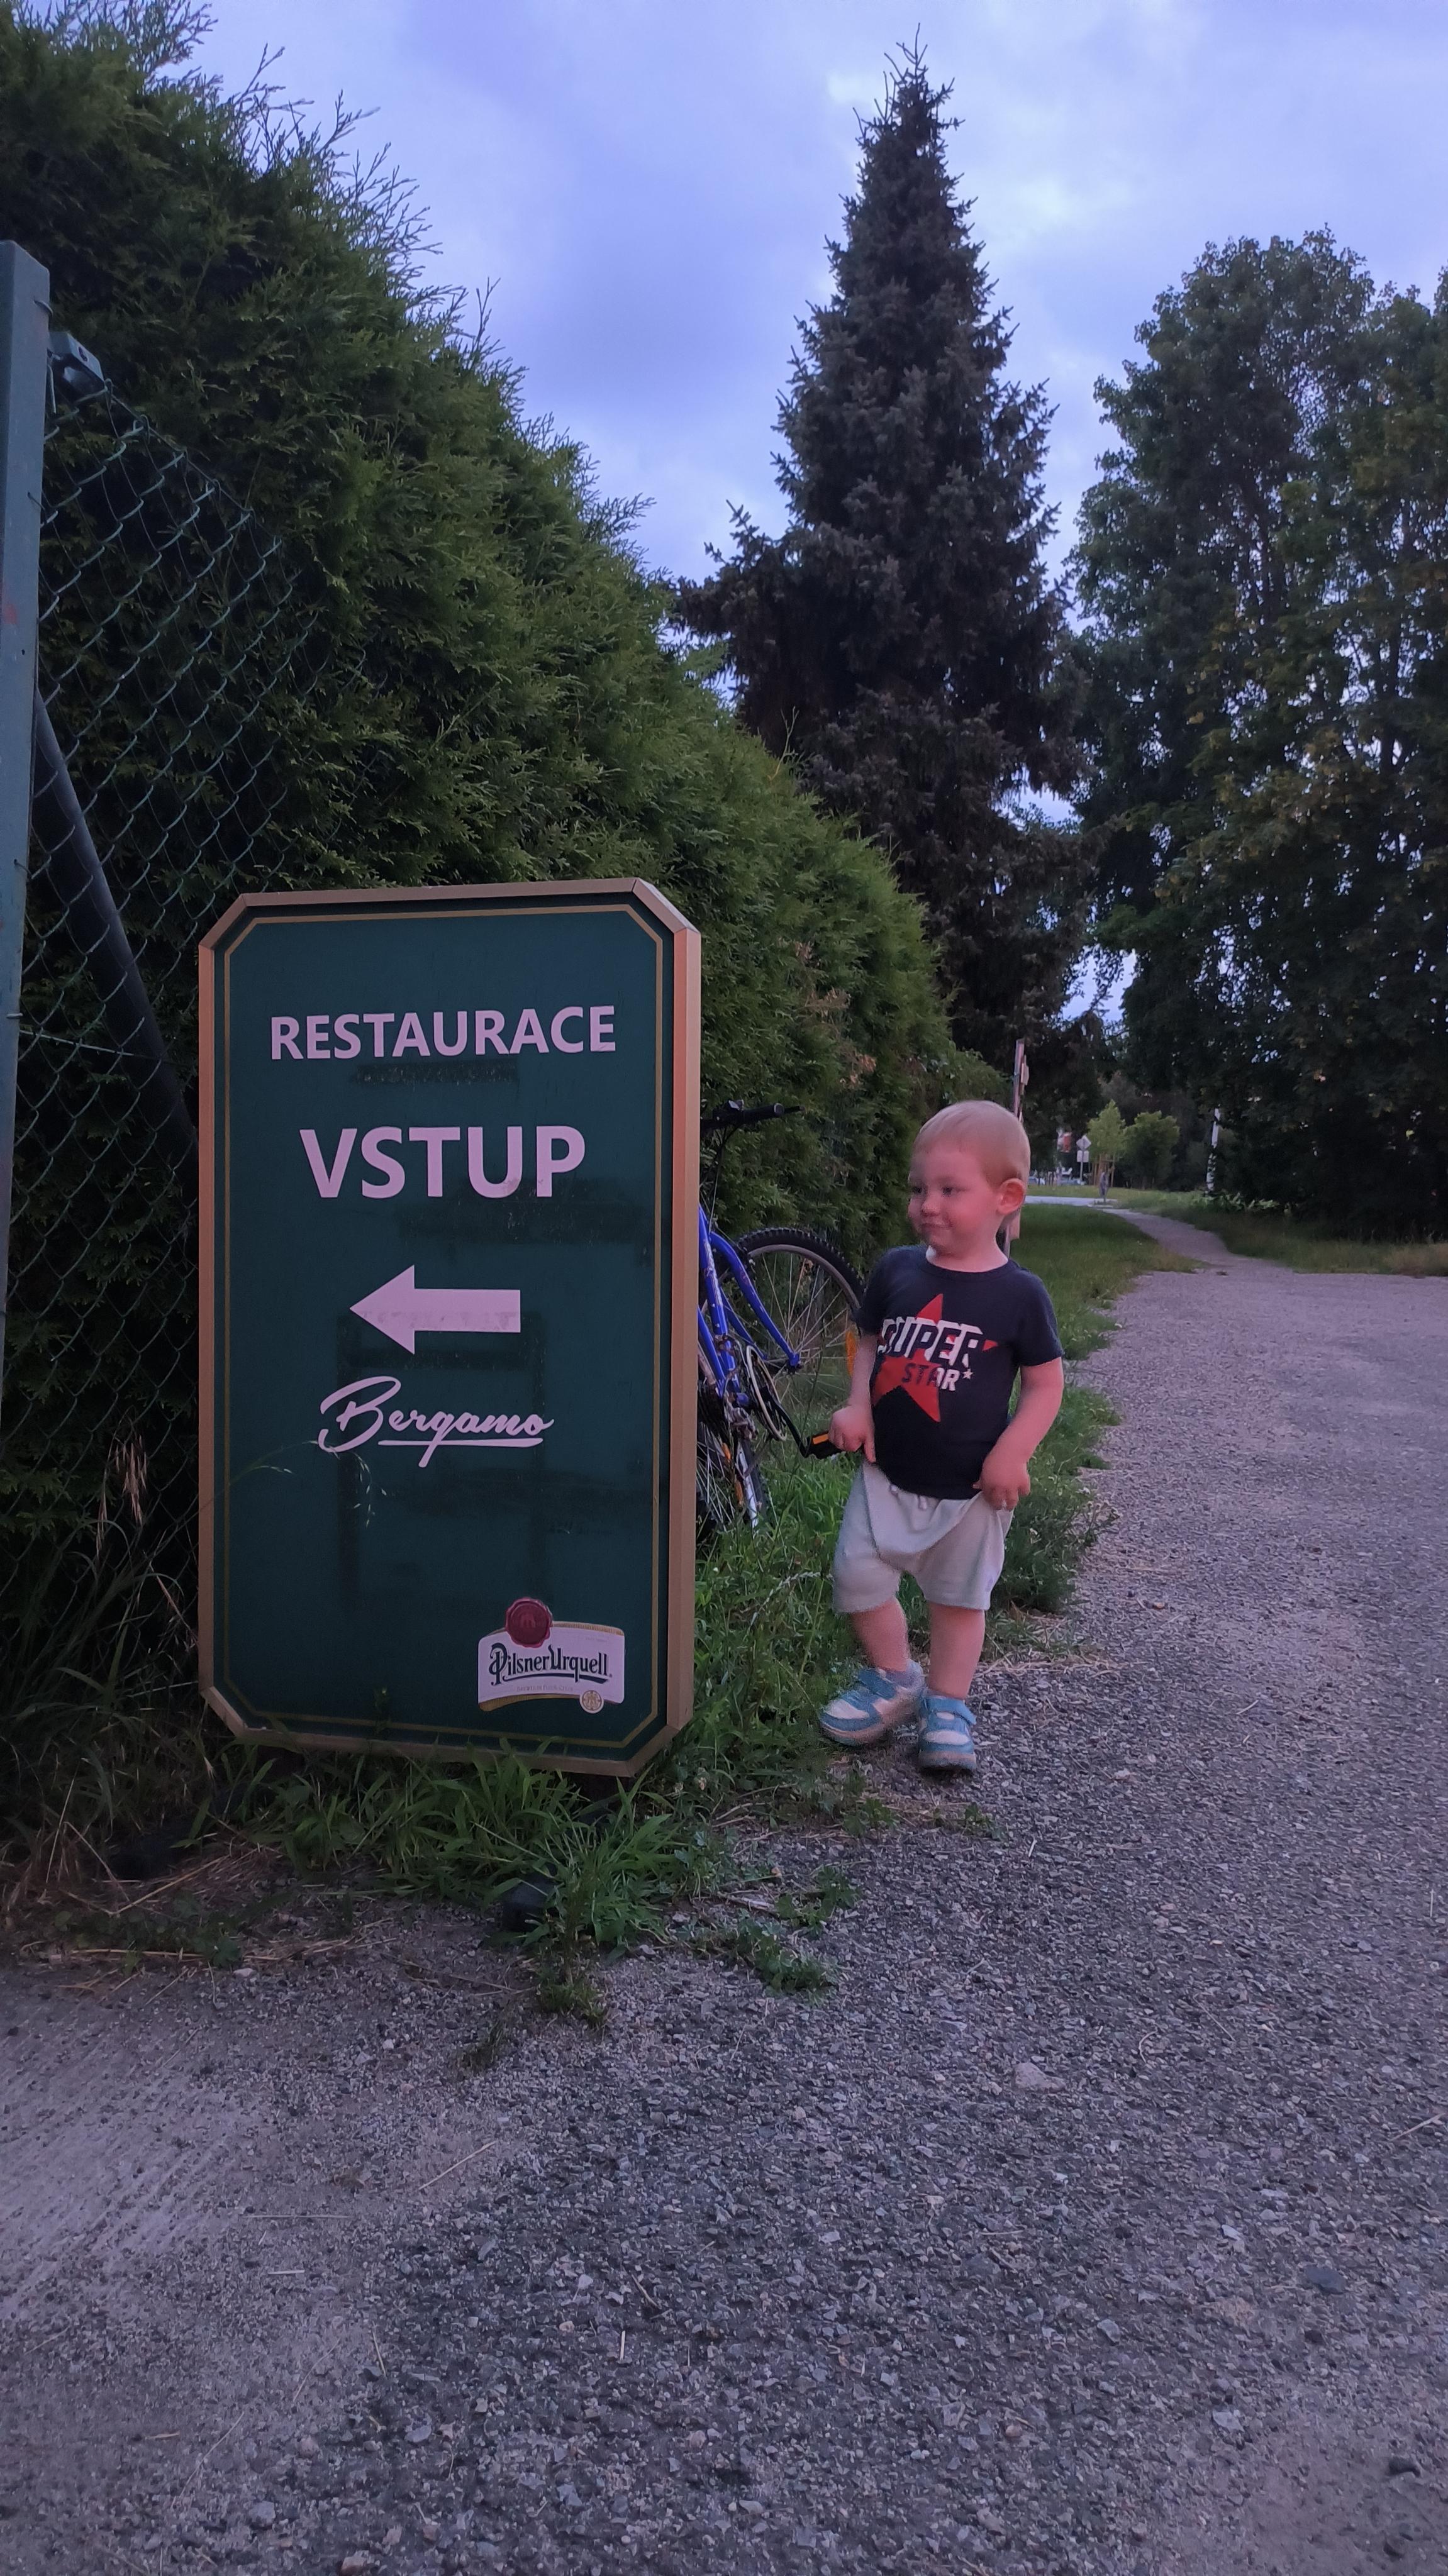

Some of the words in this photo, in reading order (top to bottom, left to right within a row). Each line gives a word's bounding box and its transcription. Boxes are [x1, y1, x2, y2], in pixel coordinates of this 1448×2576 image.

[270, 1005, 616, 1060] RESTAURACE
[299, 1125, 586, 1200] VSTUP
[877, 1316, 985, 1368] SUPER
[901, 1362, 961, 1392] STAR
[318, 1375, 555, 1468] Bergamo
[489, 1642, 550, 1686] Pilsner
[547, 1644, 608, 1683] Urquell
